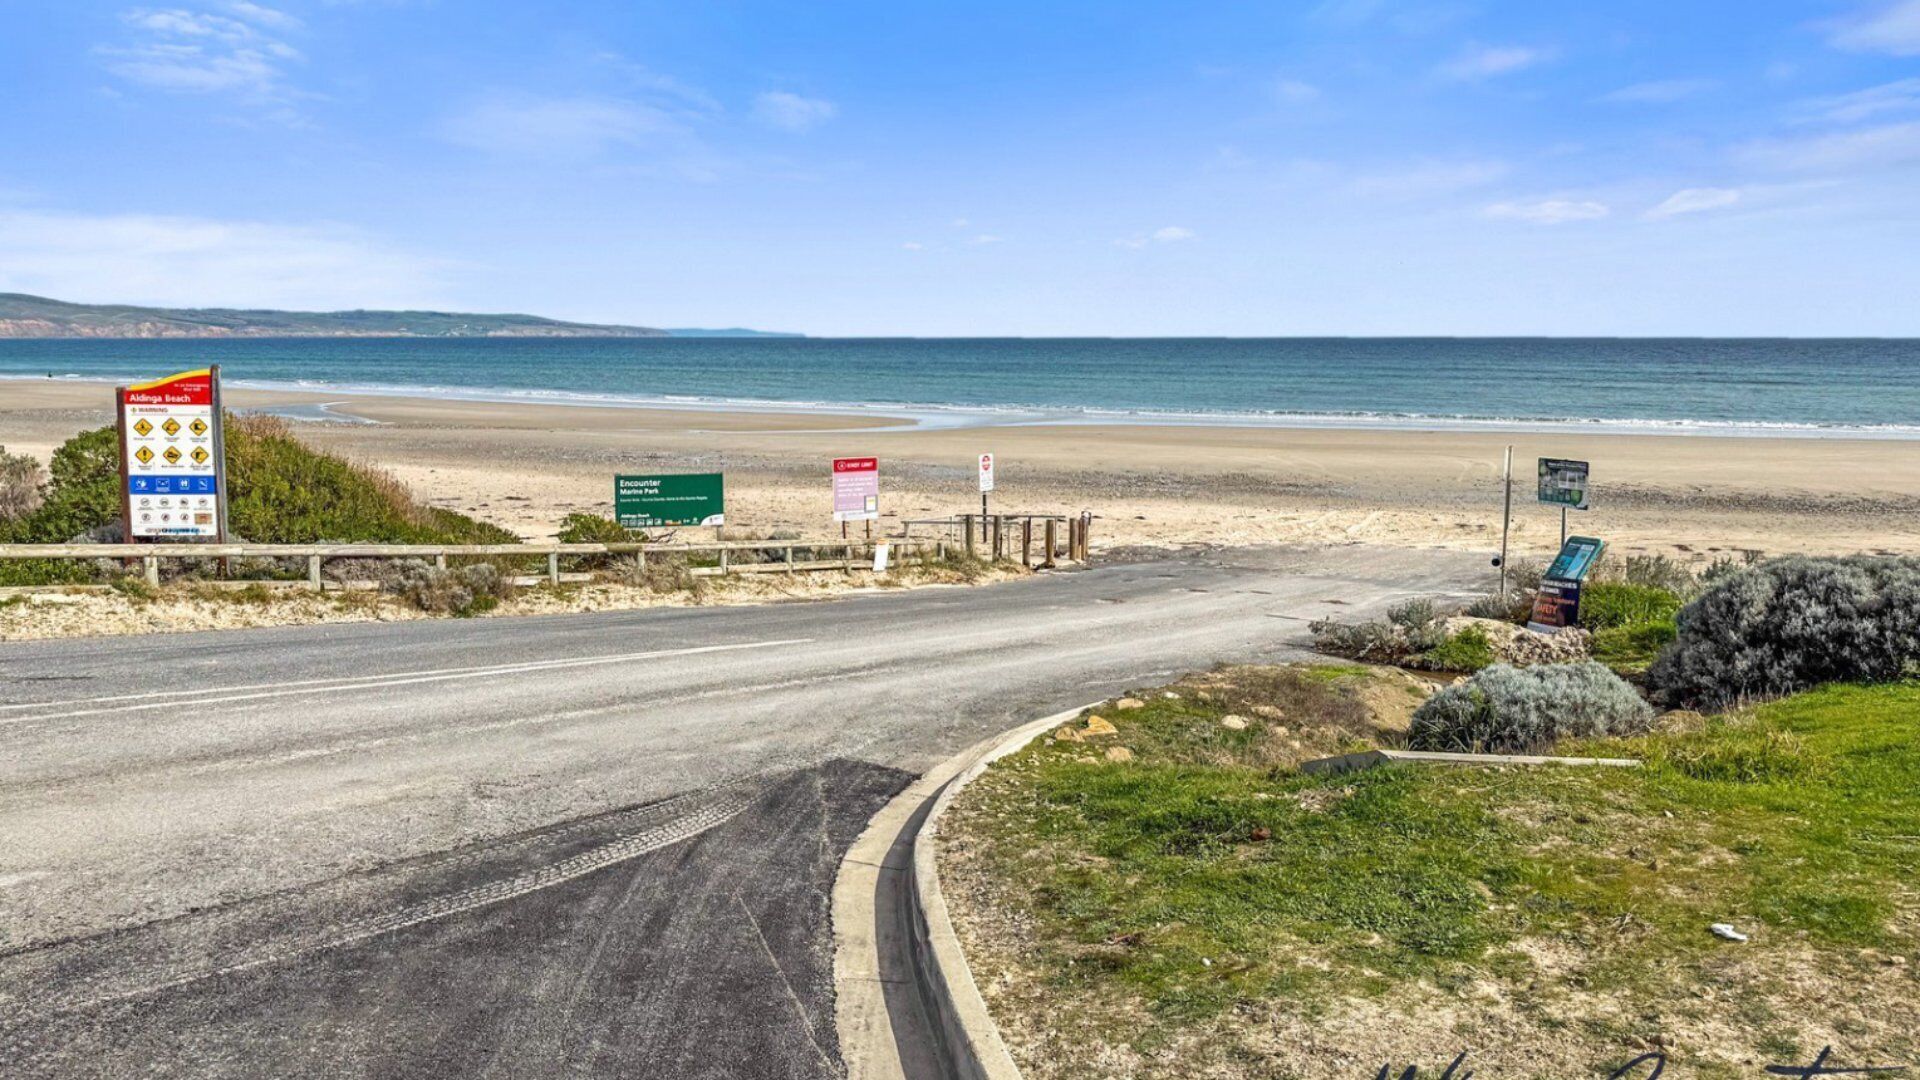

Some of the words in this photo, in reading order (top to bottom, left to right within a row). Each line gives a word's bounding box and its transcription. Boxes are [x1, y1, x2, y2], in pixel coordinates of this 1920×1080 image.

[129, 394, 163, 404] Aldinga
[165, 394, 191, 403] Beach
[620, 479, 661, 487] Encounter
